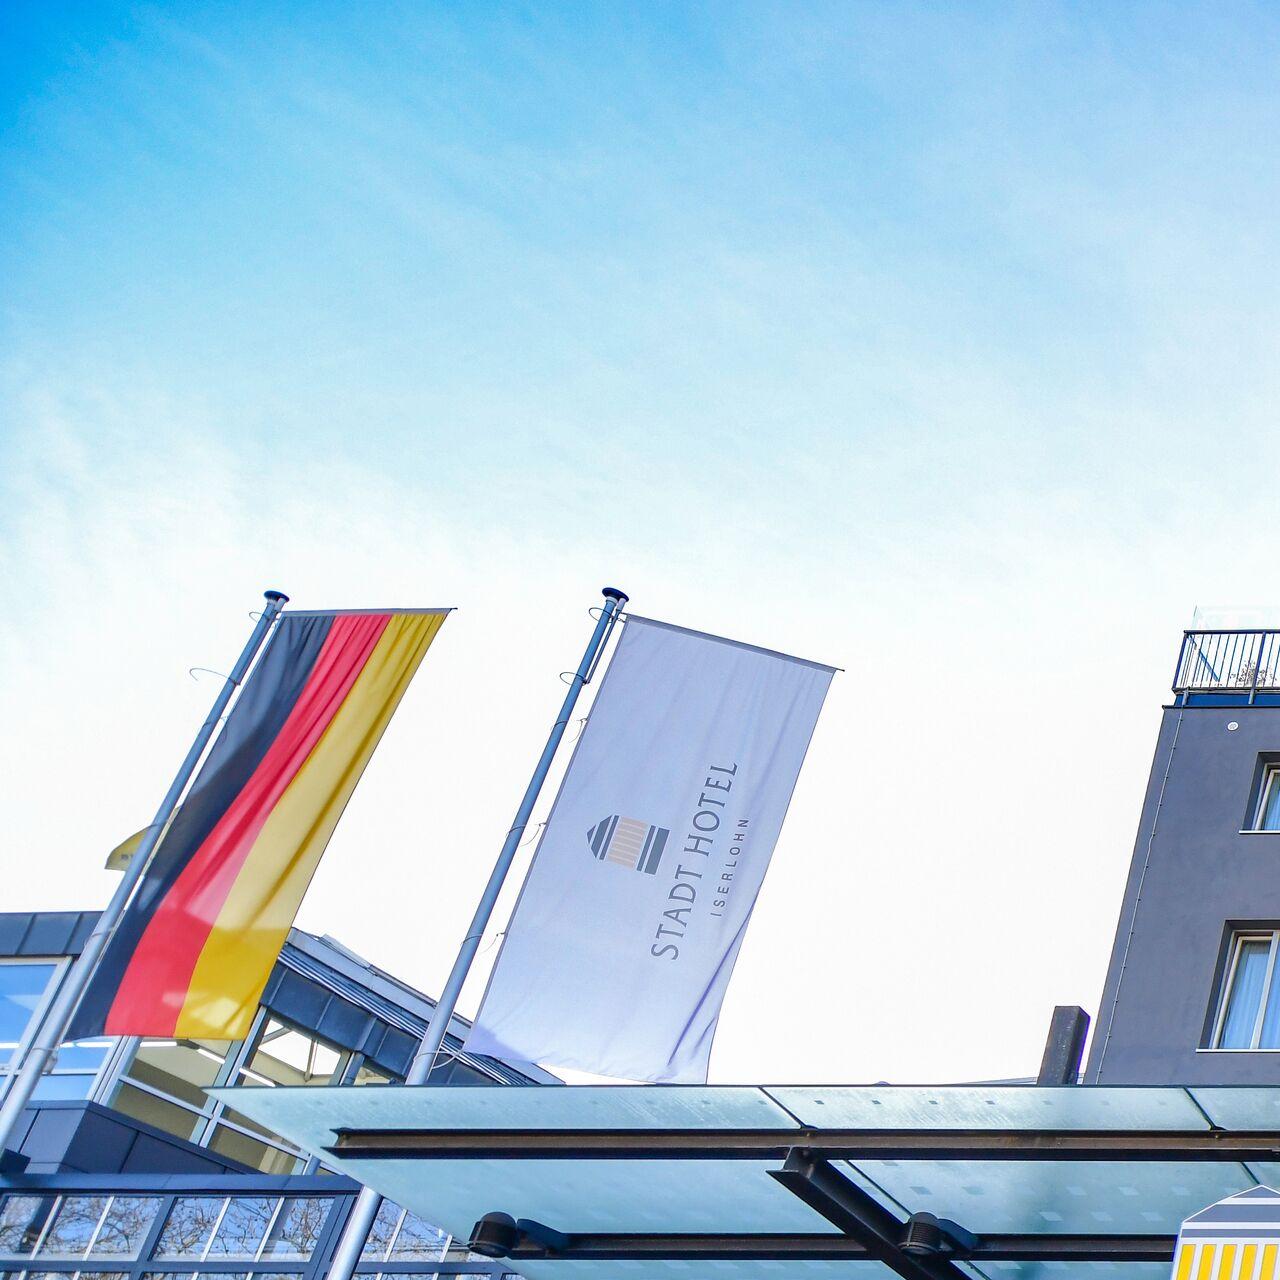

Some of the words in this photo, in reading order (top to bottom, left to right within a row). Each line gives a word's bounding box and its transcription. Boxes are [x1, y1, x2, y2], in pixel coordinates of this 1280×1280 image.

[651, 864, 702, 960] STADT
[684, 762, 738, 857] HOTEL
[710, 818, 750, 917] ISERLOHN
